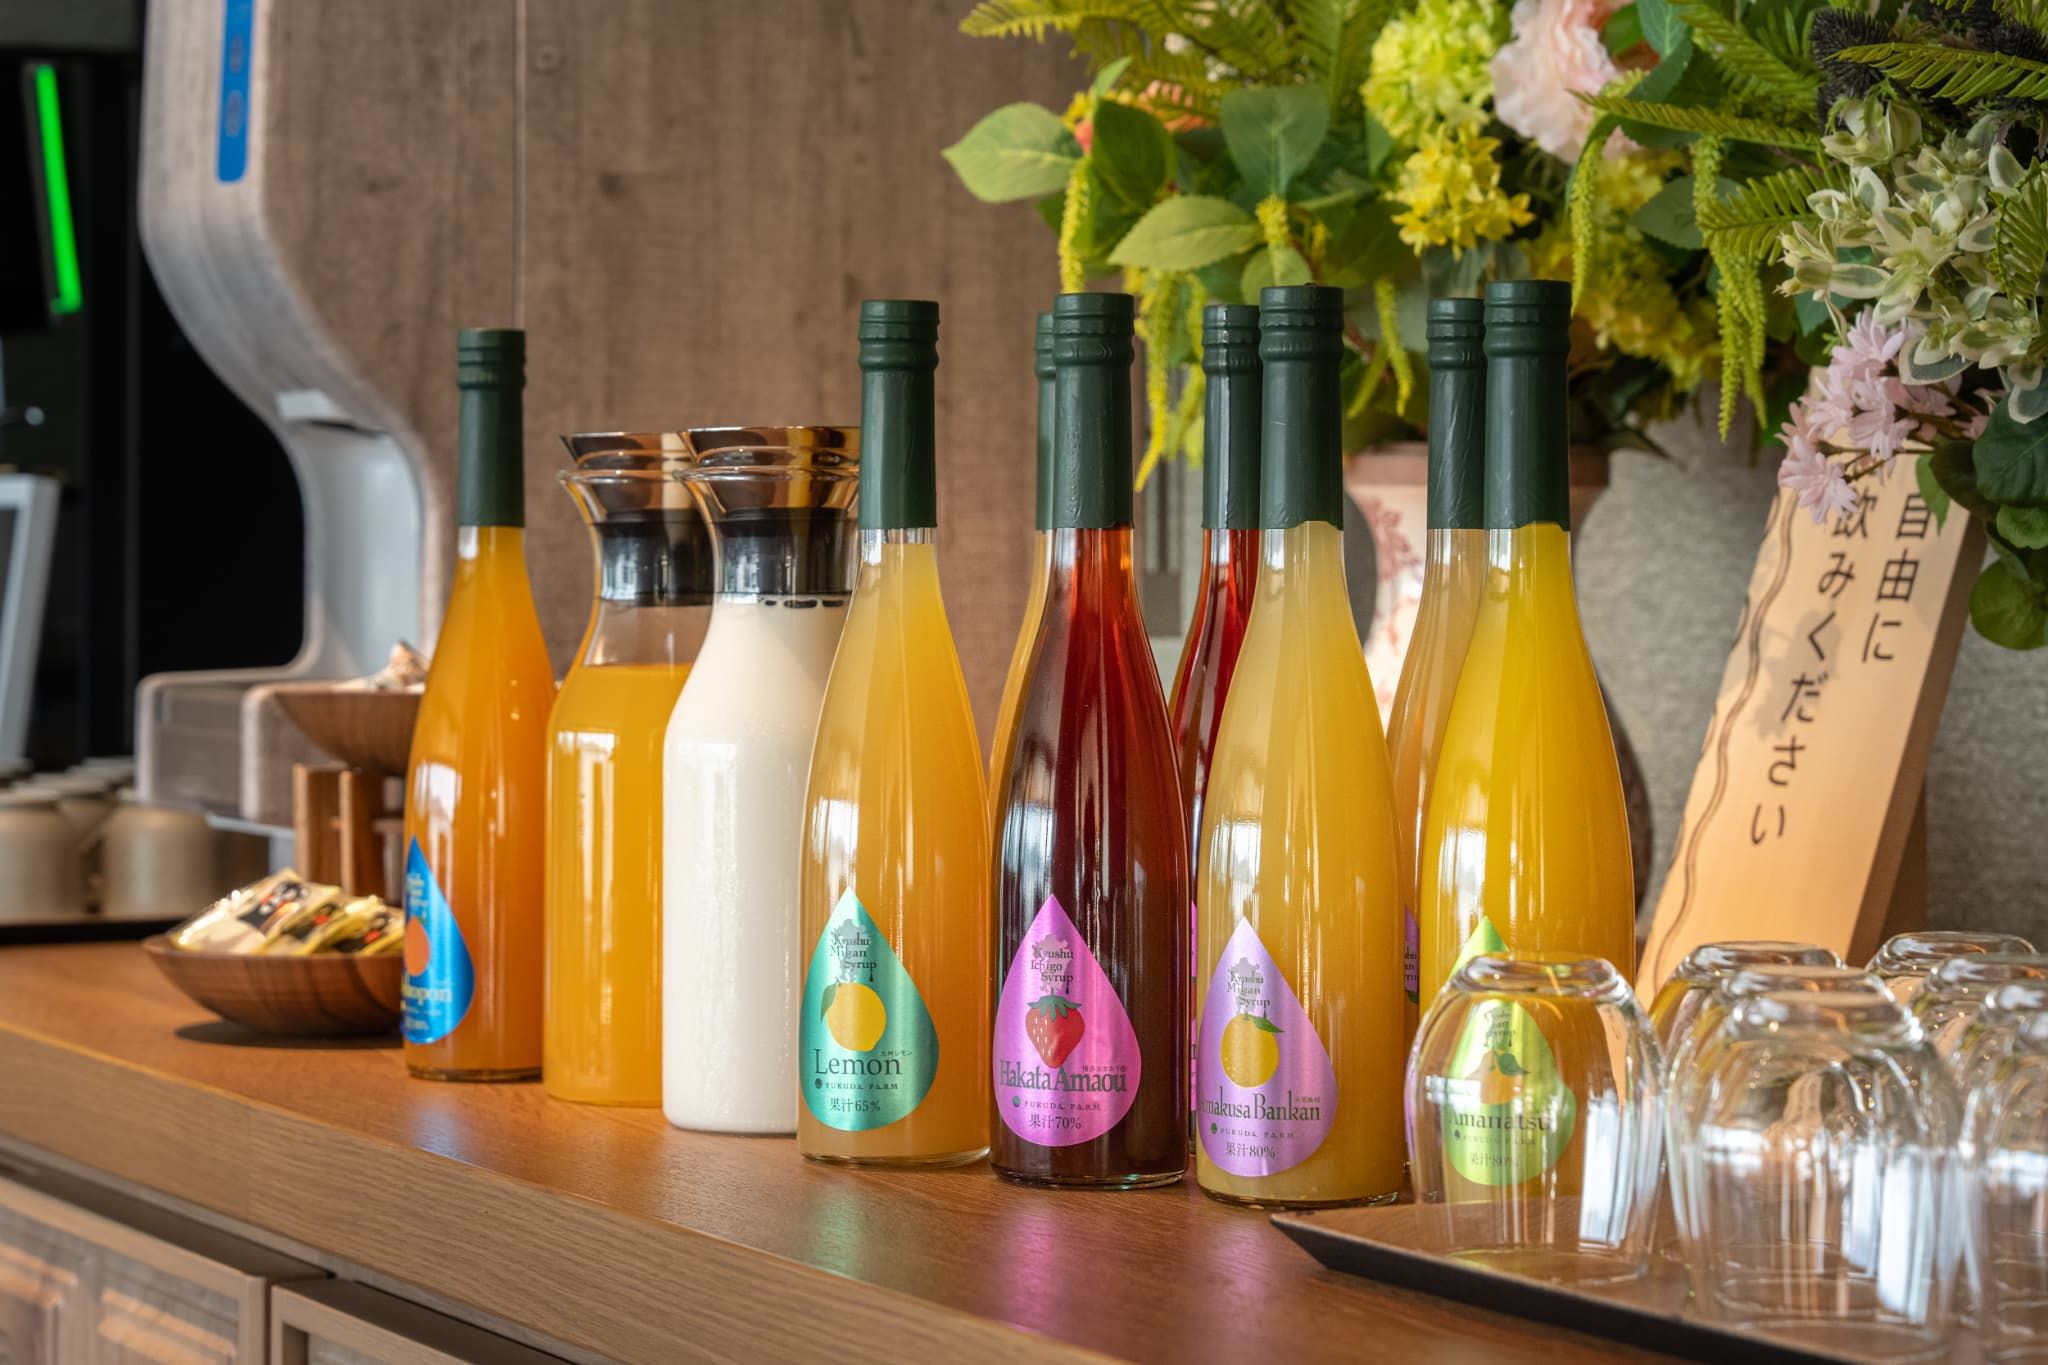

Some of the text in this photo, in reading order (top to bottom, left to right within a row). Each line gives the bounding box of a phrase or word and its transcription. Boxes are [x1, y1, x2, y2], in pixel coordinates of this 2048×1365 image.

[1862, 493, 1932, 663] 自由に
[1033, 947, 1074, 961] Kyushu
[843, 960, 877, 976] Syrup
[1030, 959, 1063, 973] Ichigo
[1041, 971, 1074, 987] Syrup
[813, 1048, 903, 1075] Lemon
[1000, 1060, 1128, 1092] Hakata Amaou
[830, 1098, 881, 1112] 果汁65%
[1252, 1090, 1321, 1121] Bankan
[1030, 1113, 1082, 1129] 果汁70%
[1225, 1141, 1276, 1158] 果汁80%
